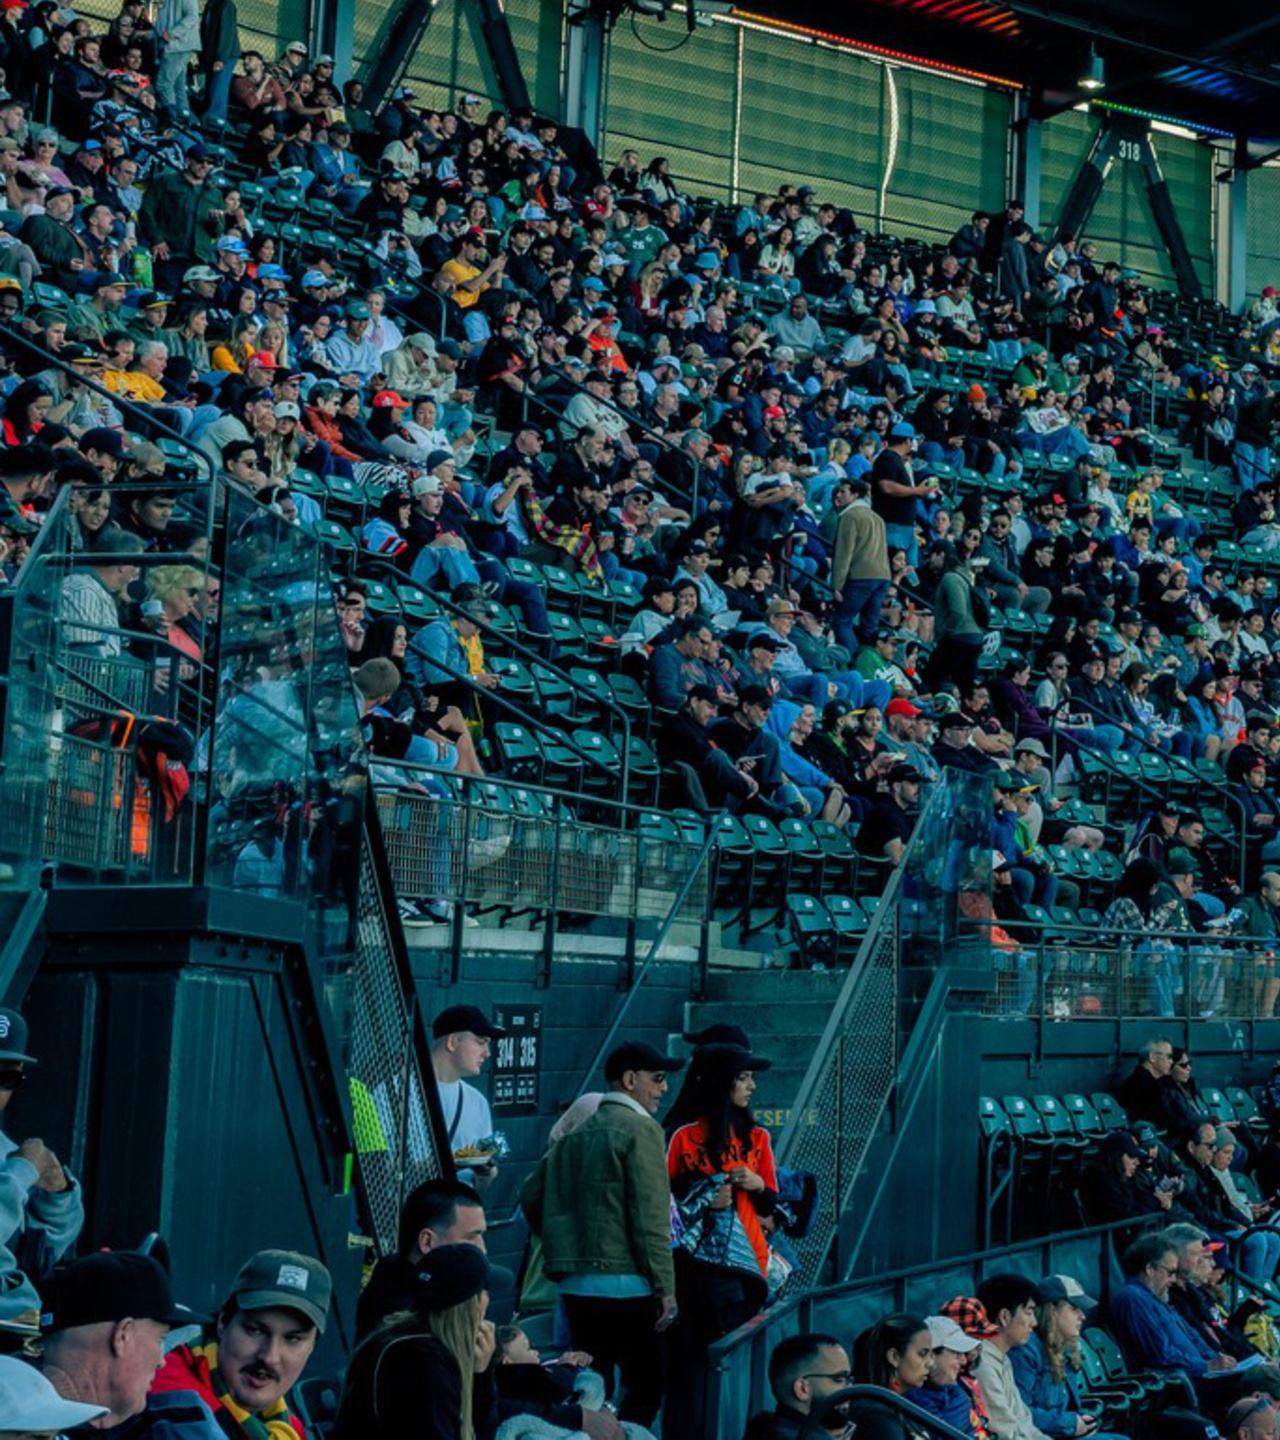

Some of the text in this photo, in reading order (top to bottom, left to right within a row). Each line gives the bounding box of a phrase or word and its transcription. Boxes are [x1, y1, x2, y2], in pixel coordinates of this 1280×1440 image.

[1119, 140, 1141, 161] 318
[496, 1037, 537, 1068] 314 315
